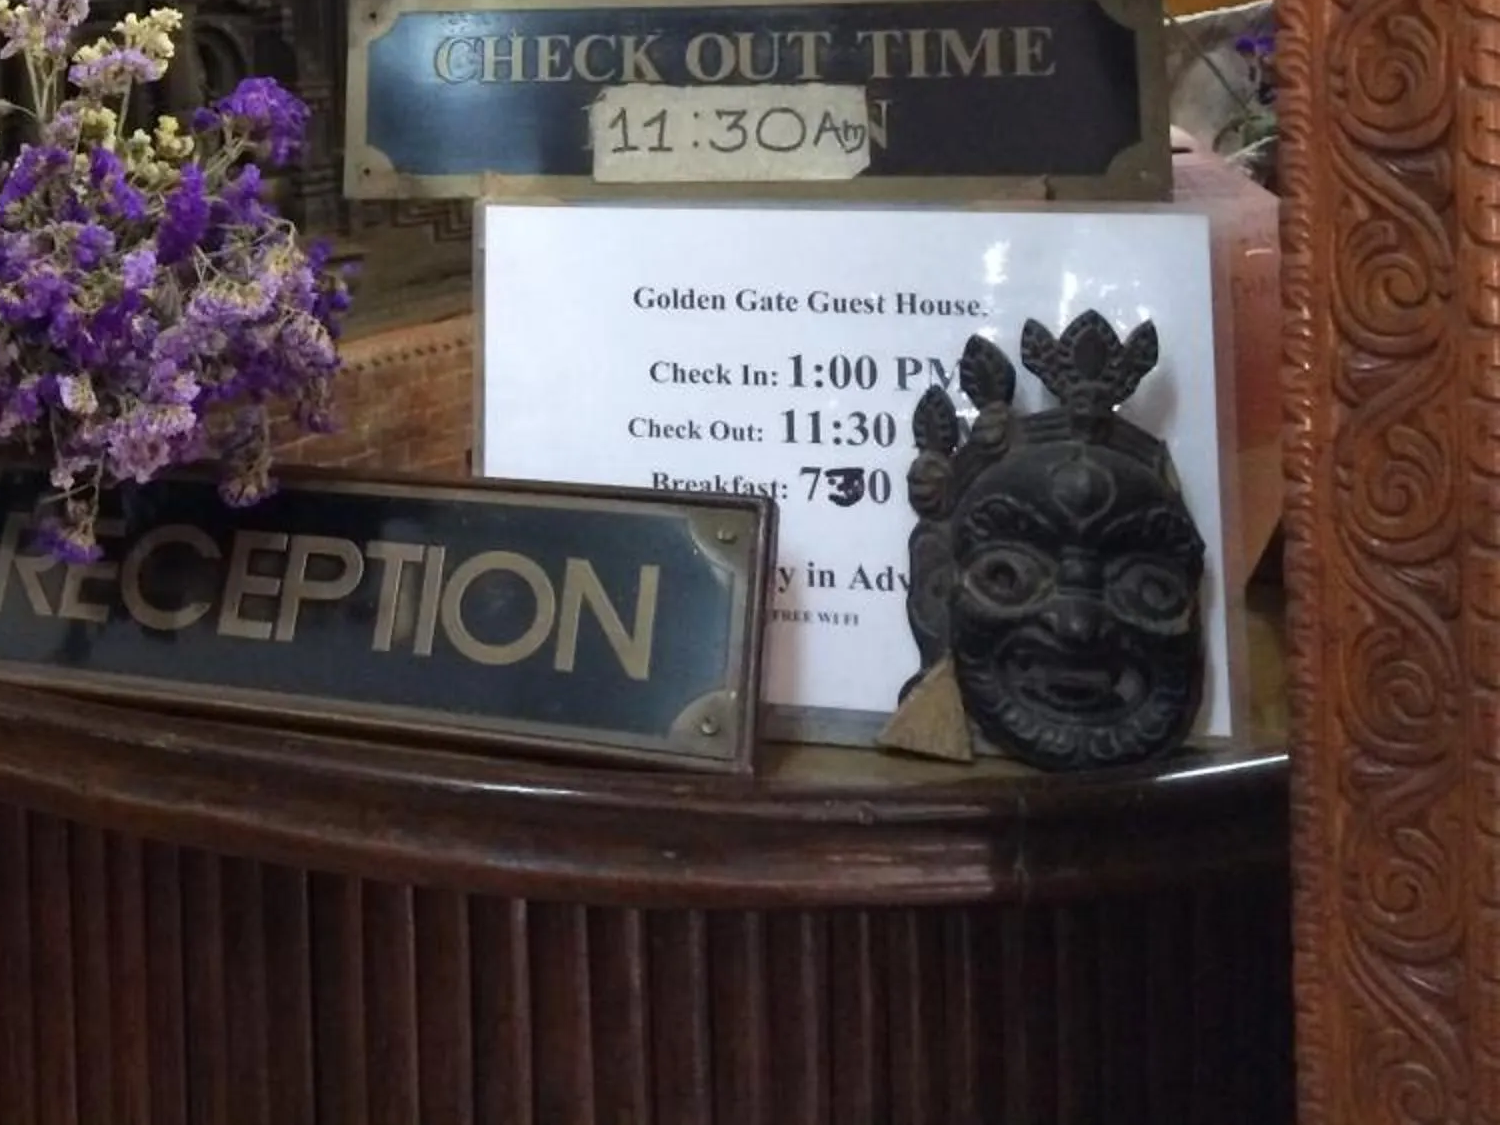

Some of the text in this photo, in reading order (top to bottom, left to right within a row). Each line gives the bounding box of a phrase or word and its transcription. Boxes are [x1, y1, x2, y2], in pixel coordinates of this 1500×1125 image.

[433, 26, 1056, 84] CHECK OUT TIME
[633, 286, 726, 312] Golden
[735, 288, 799, 313] Gate
[807, 290, 886, 315] Guest
[649, 360, 731, 386] Check
[741, 364, 779, 387] In:
[788, 352, 878, 390] 1:00
[628, 416, 702, 440] Check
[709, 420, 763, 443] Out:
[781, 409, 897, 448] 11:30
[652, 471, 788, 500] Breakfast:
[806, 561, 836, 588] in
